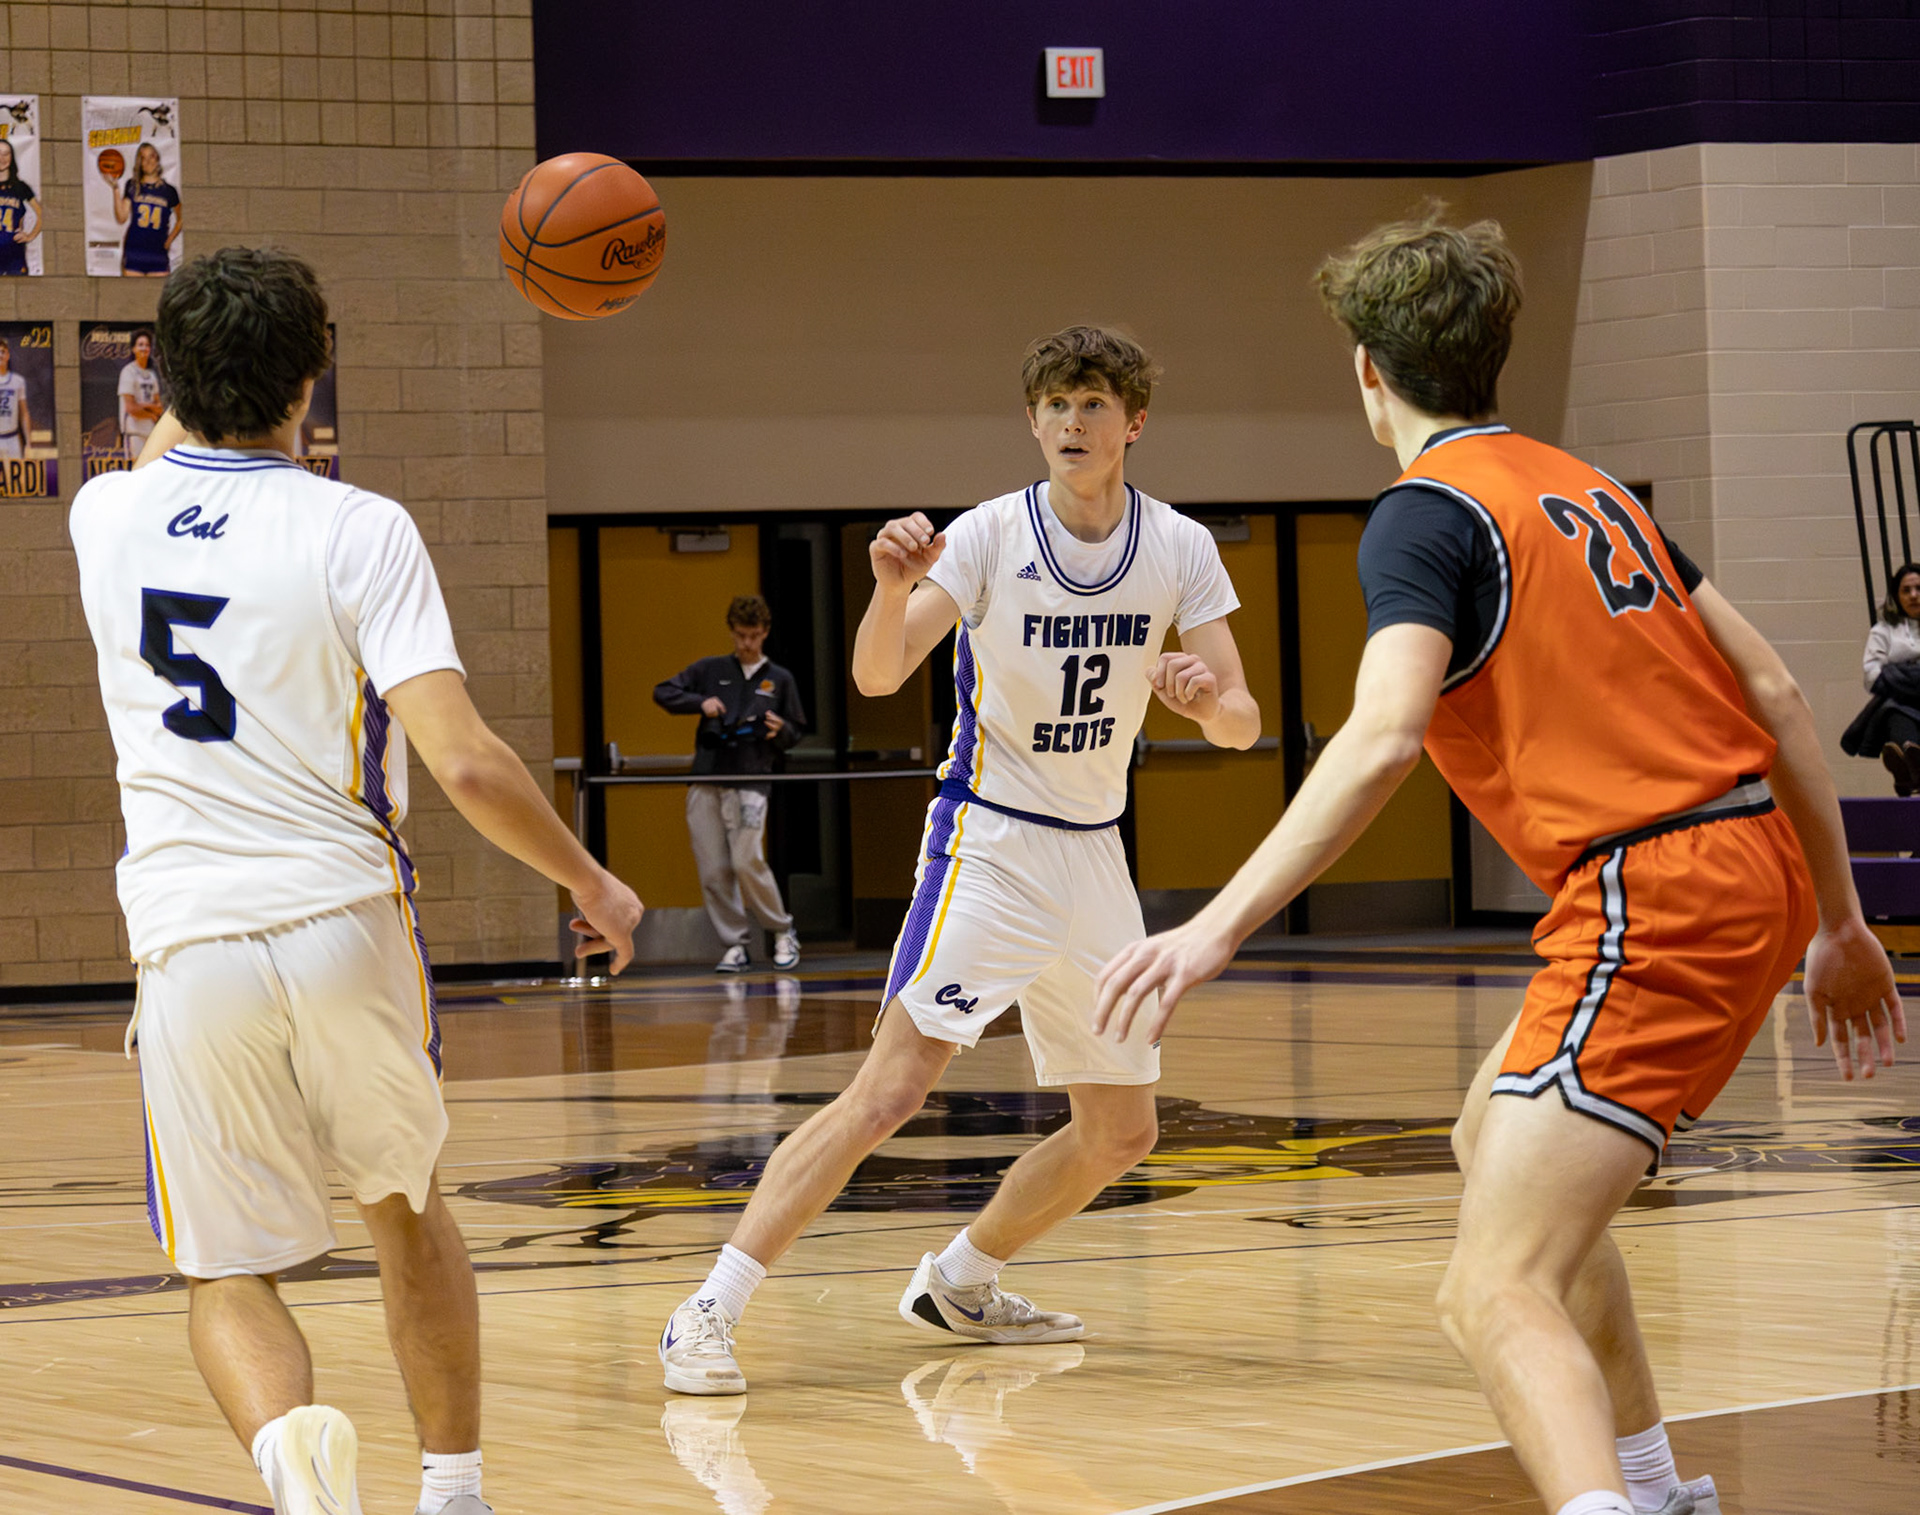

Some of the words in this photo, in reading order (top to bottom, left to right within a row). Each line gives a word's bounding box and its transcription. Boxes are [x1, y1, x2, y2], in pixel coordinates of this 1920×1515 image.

[1057, 56, 1095, 88] EXIT
[137, 203, 162, 230] 34
[20, 326, 51, 348] #22
[167, 504, 229, 540] Cal
[1538, 487, 1687, 618] 21
[1016, 572, 1041, 582] adidas
[1023, 613, 1152, 648] FIGHTING
[139, 587, 236, 742] 5
[1060, 653, 1111, 717] 12
[1032, 717, 1116, 753] SCOTS
[935, 983, 979, 1014] Cal
